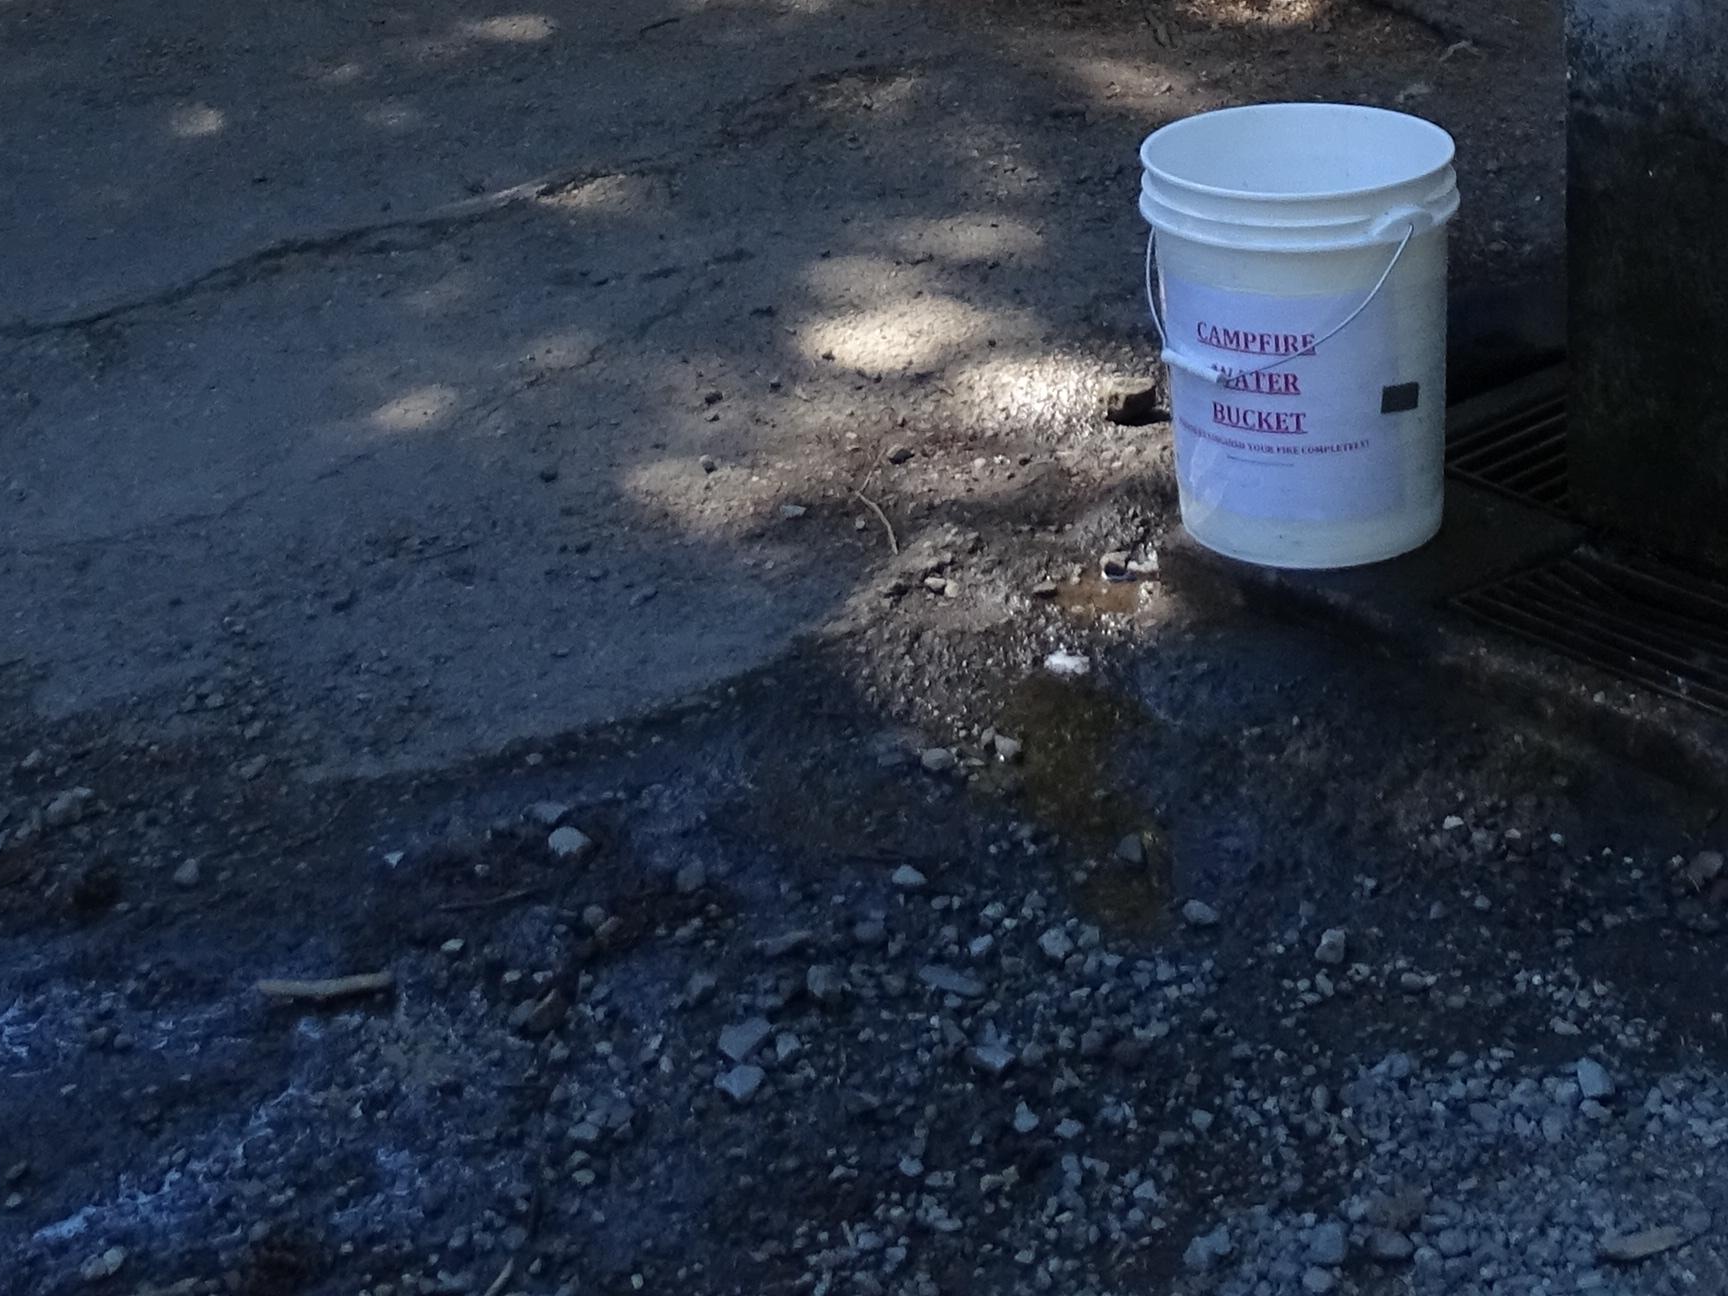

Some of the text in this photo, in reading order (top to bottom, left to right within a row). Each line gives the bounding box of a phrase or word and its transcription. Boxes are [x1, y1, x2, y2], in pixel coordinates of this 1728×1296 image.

[1196, 321, 1317, 356] CAMPFIRE
[1212, 400, 1307, 432] BUCKET
[1247, 442, 1273, 454] YOUR
[1276, 444, 1299, 456] FIRE
